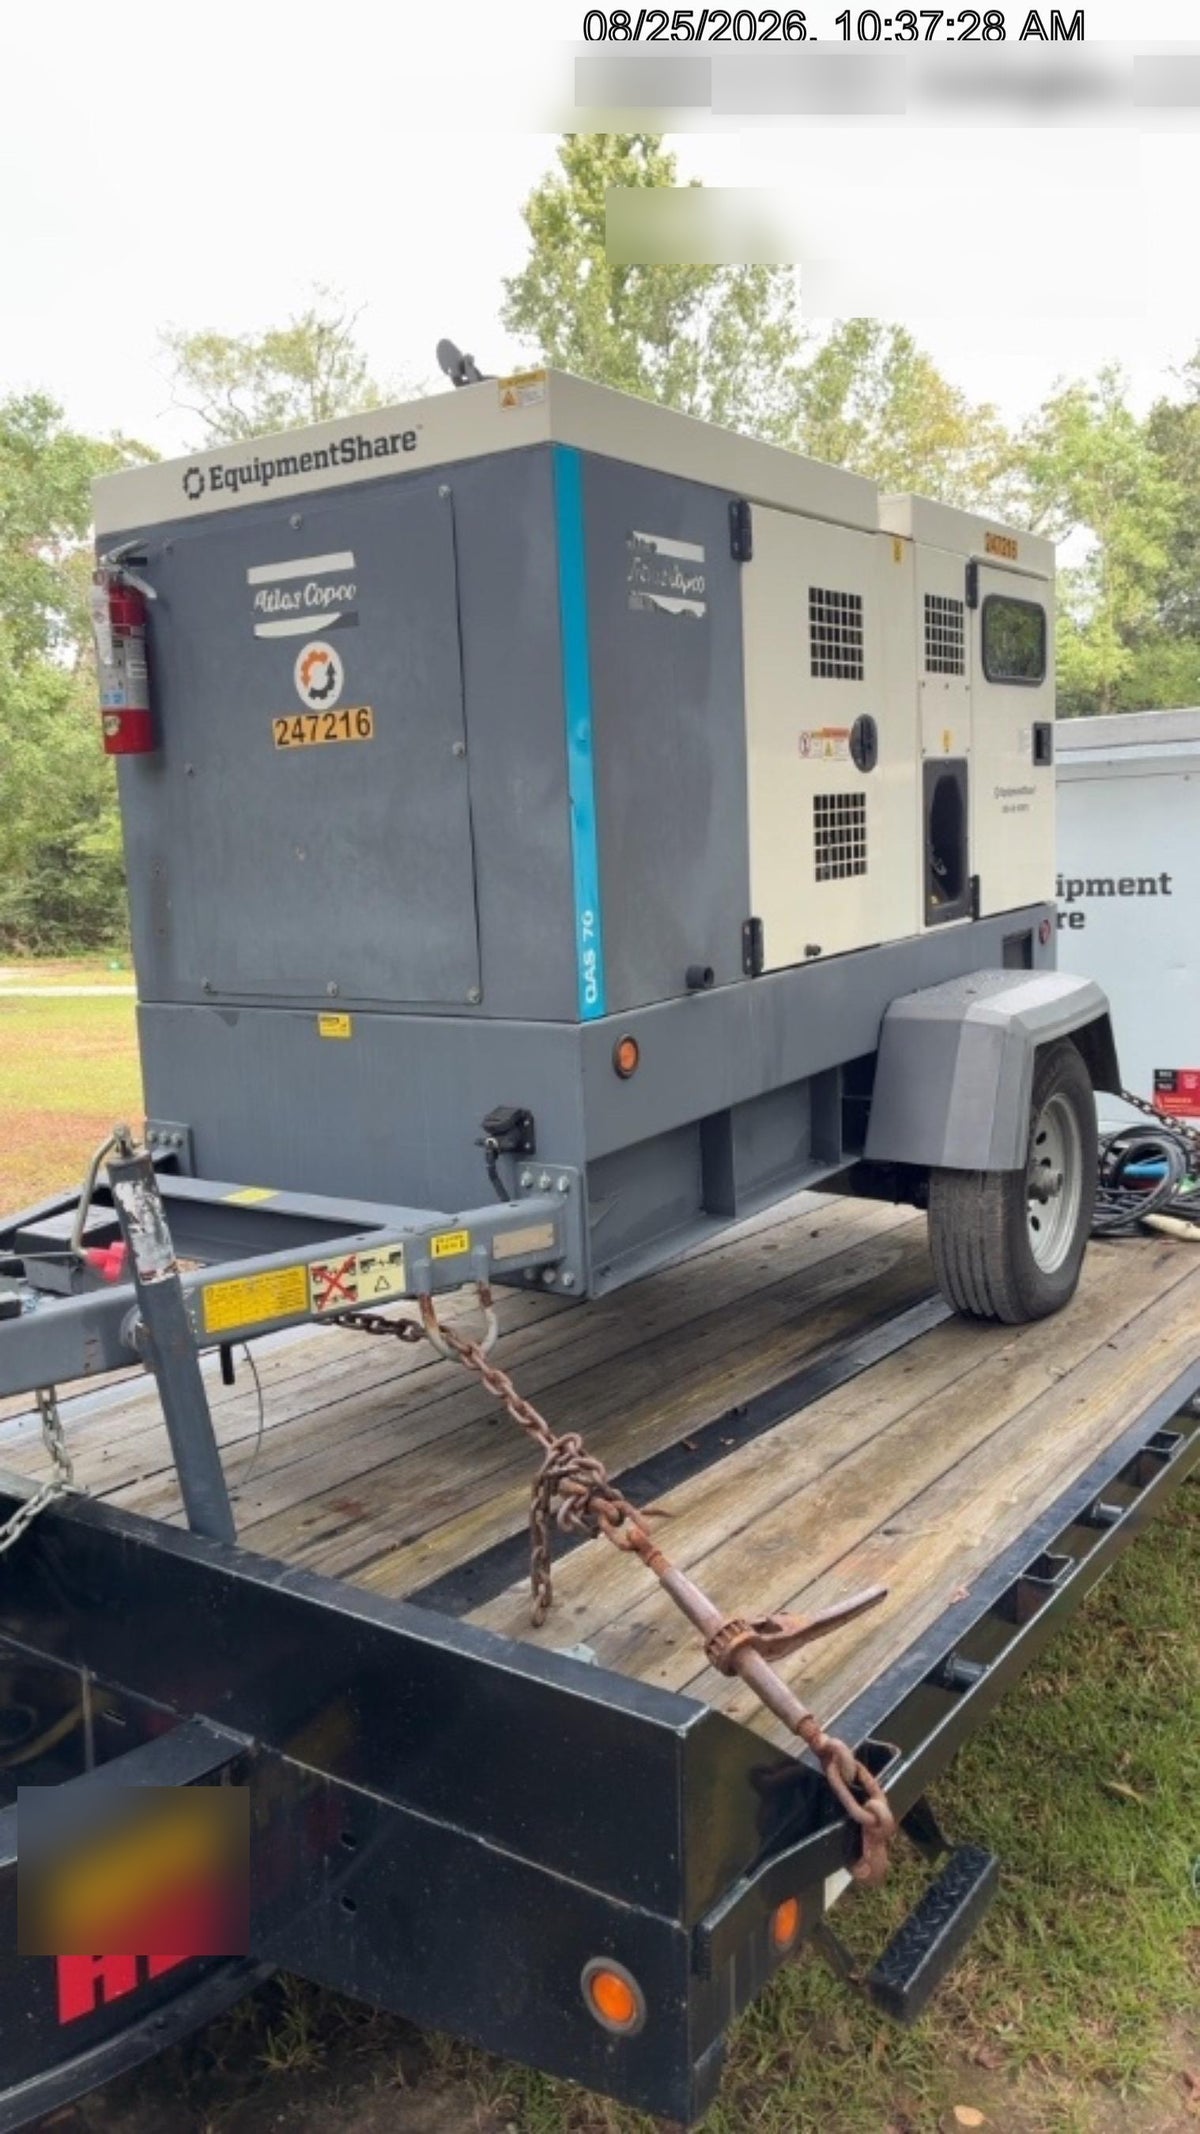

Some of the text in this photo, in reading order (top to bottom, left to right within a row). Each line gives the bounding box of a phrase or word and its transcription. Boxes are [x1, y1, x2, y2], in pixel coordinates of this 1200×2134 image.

[209, 429, 417, 492] EquipmentShare
[254, 582, 357, 613] Atlas Copco
[274, 708, 371, 746] 247216
[1055, 872, 1173, 902] ipment
[582, 909, 595, 942] 70
